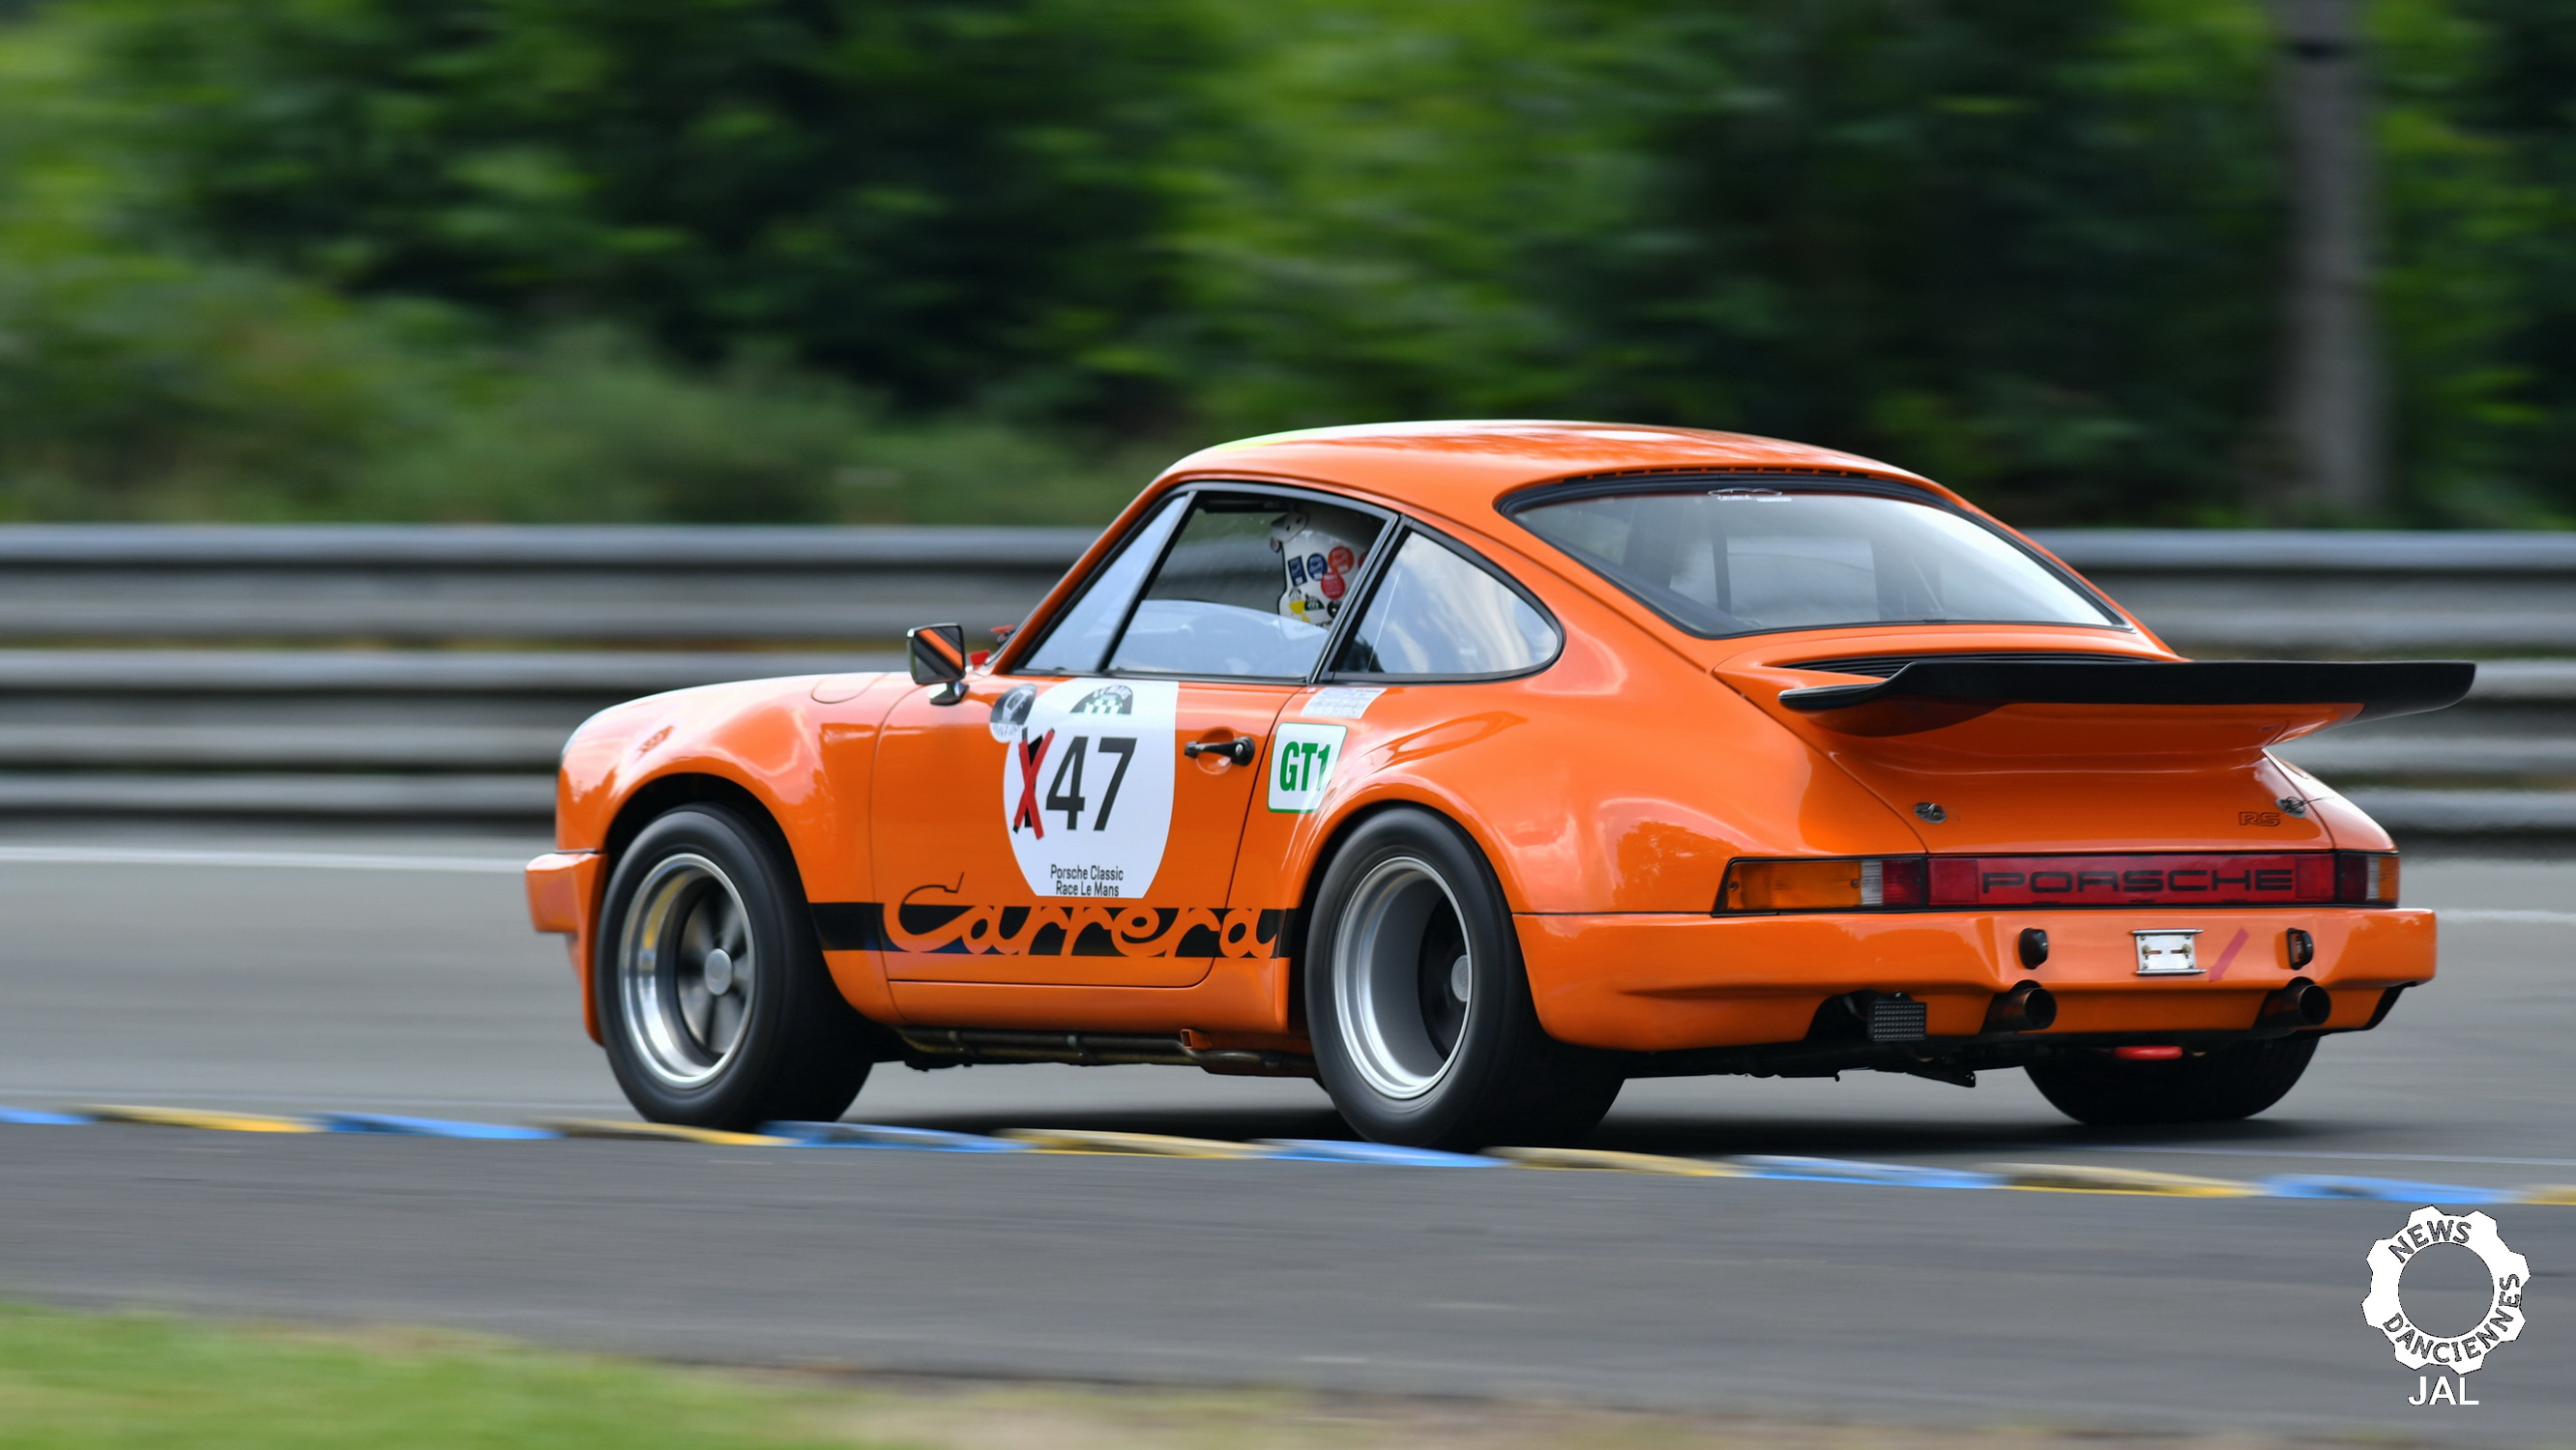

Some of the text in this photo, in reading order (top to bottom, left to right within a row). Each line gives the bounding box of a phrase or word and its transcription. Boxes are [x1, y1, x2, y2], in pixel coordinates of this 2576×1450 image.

[1279, 740, 1331, 792] GT1
[2238, 811, 2281, 827] RS
[1050, 863, 1125, 881] Porsche Classic
[1982, 869, 2294, 894] PORSCHE
[1055, 880, 1120, 897] Race Le Mans
[882, 871, 1278, 960] Carrera
